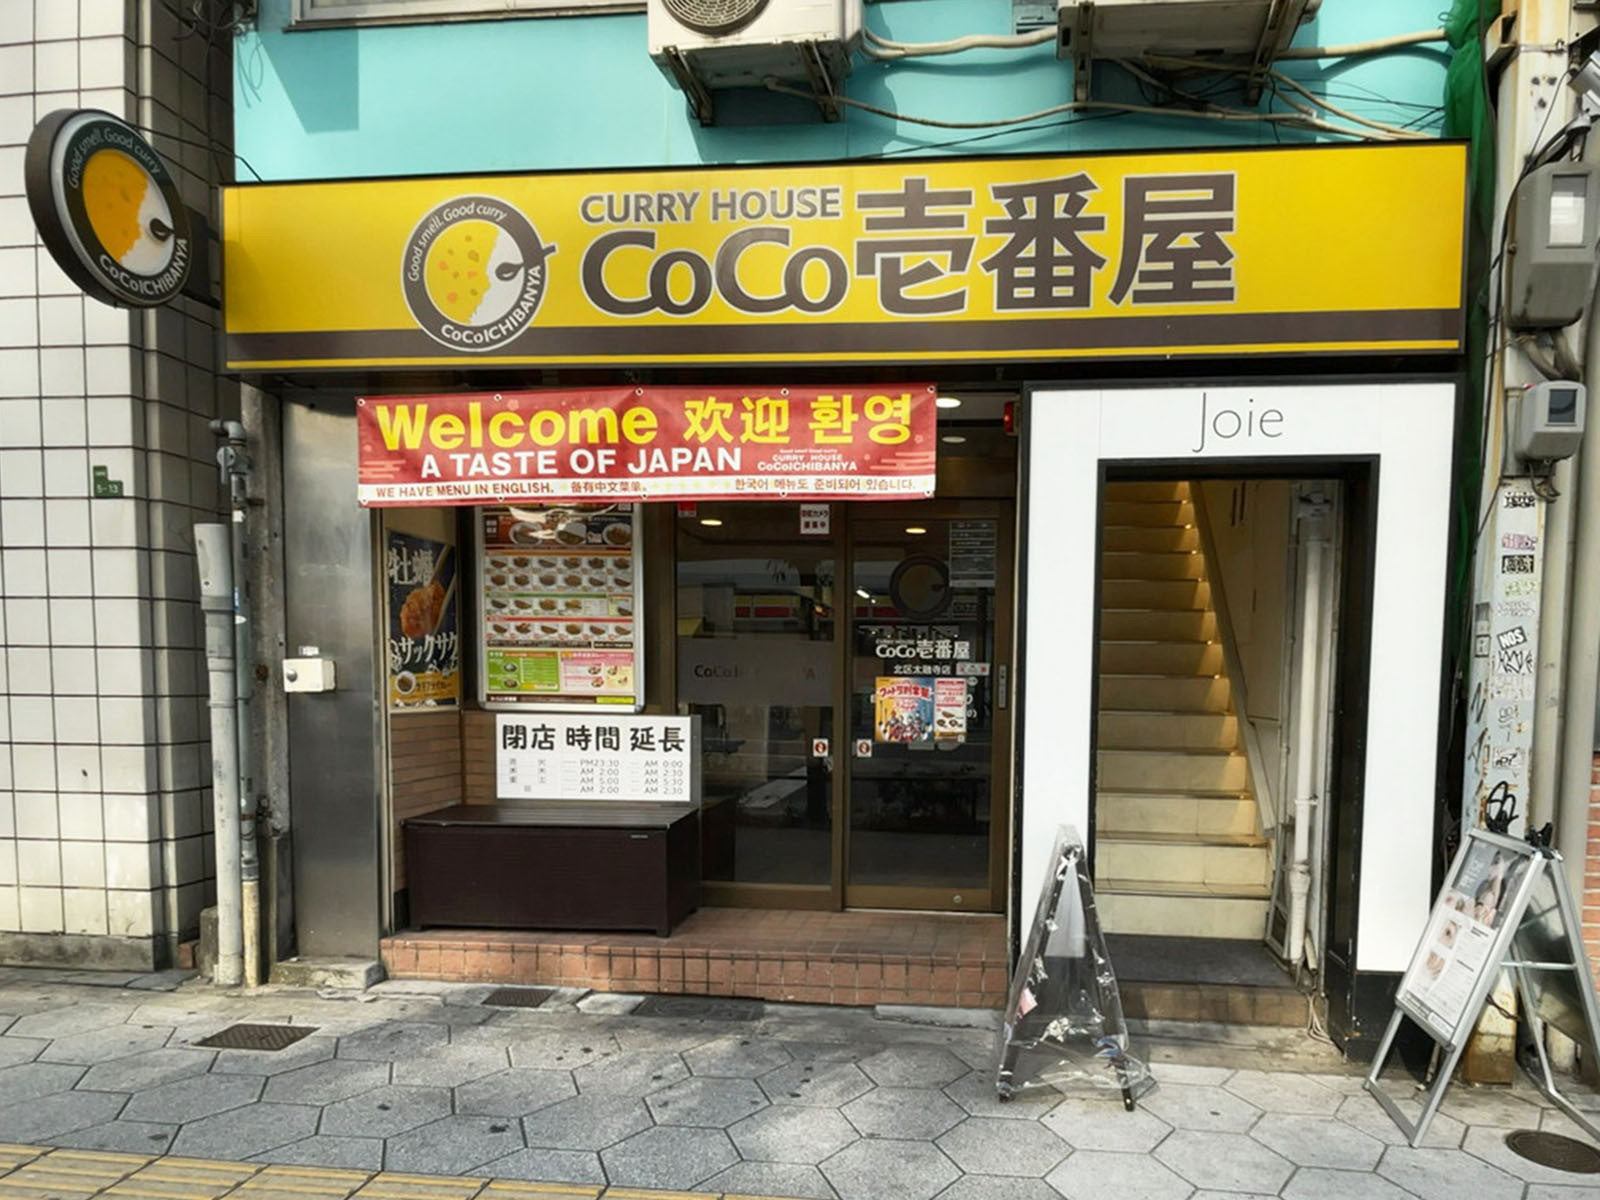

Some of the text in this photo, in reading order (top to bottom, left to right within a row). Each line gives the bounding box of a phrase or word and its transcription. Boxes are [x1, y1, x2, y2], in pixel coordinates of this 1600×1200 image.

[69, 149, 83, 189] Good
[104, 127, 134, 148] Good
[134, 146, 160, 174] curry
[580, 187, 840, 223] CURRY HOUSE
[408, 246, 422, 282] Good
[443, 202, 474, 221] Good
[477, 204, 507, 222] curry
[581, 171, 1236, 316] CoCo壱番屋
[99, 238, 188, 295] CoCoICHIBANYA
[441, 265, 542, 343] CoCoICHIBANYA
[376, 402, 658, 450] Welcome
[683, 396, 790, 444] 欢迎
[809, 393, 911, 445] 환영
[1192, 391, 1283, 453] Joie
[421, 447, 741, 478] A TASTE OF JAPAN
[757, 461, 857, 471] CoCoICHIBANYA
[376, 483, 554, 498] WE HAVE MENU IN ENGLISH.
[876, 640, 970, 659] CoCo壱番屋
[502, 724, 685, 752] 閉店 時間 延長
[580, 768, 594, 776] AM
[644, 769, 658, 777] AM
[580, 777, 594, 785] AM
[644, 778, 658, 786] AM
[644, 760, 658, 768] AM
[580, 786, 594, 794] AM
[644, 787, 658, 795] AM
